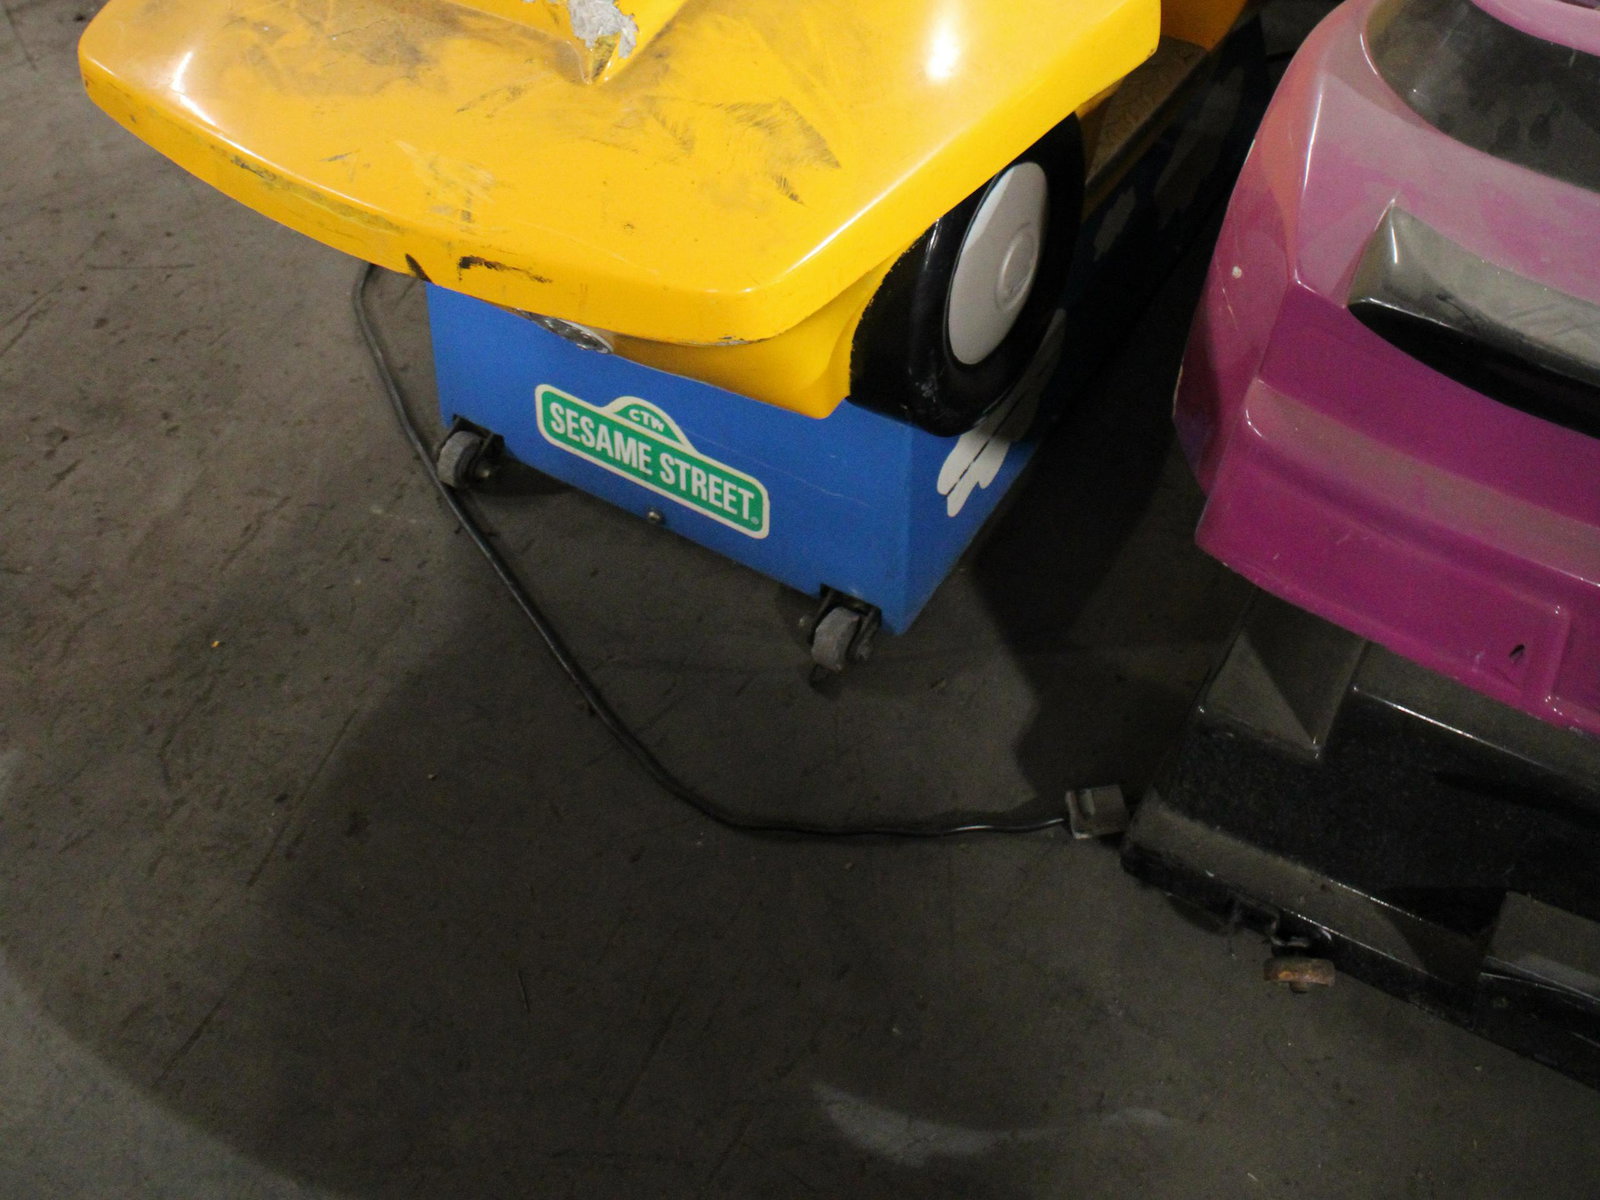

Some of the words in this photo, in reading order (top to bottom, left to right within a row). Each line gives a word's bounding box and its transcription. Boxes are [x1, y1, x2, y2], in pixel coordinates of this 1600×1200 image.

[628, 408, 665, 432] CTW
[550, 402, 653, 475] SESAME
[660, 452, 755, 520] STREET
